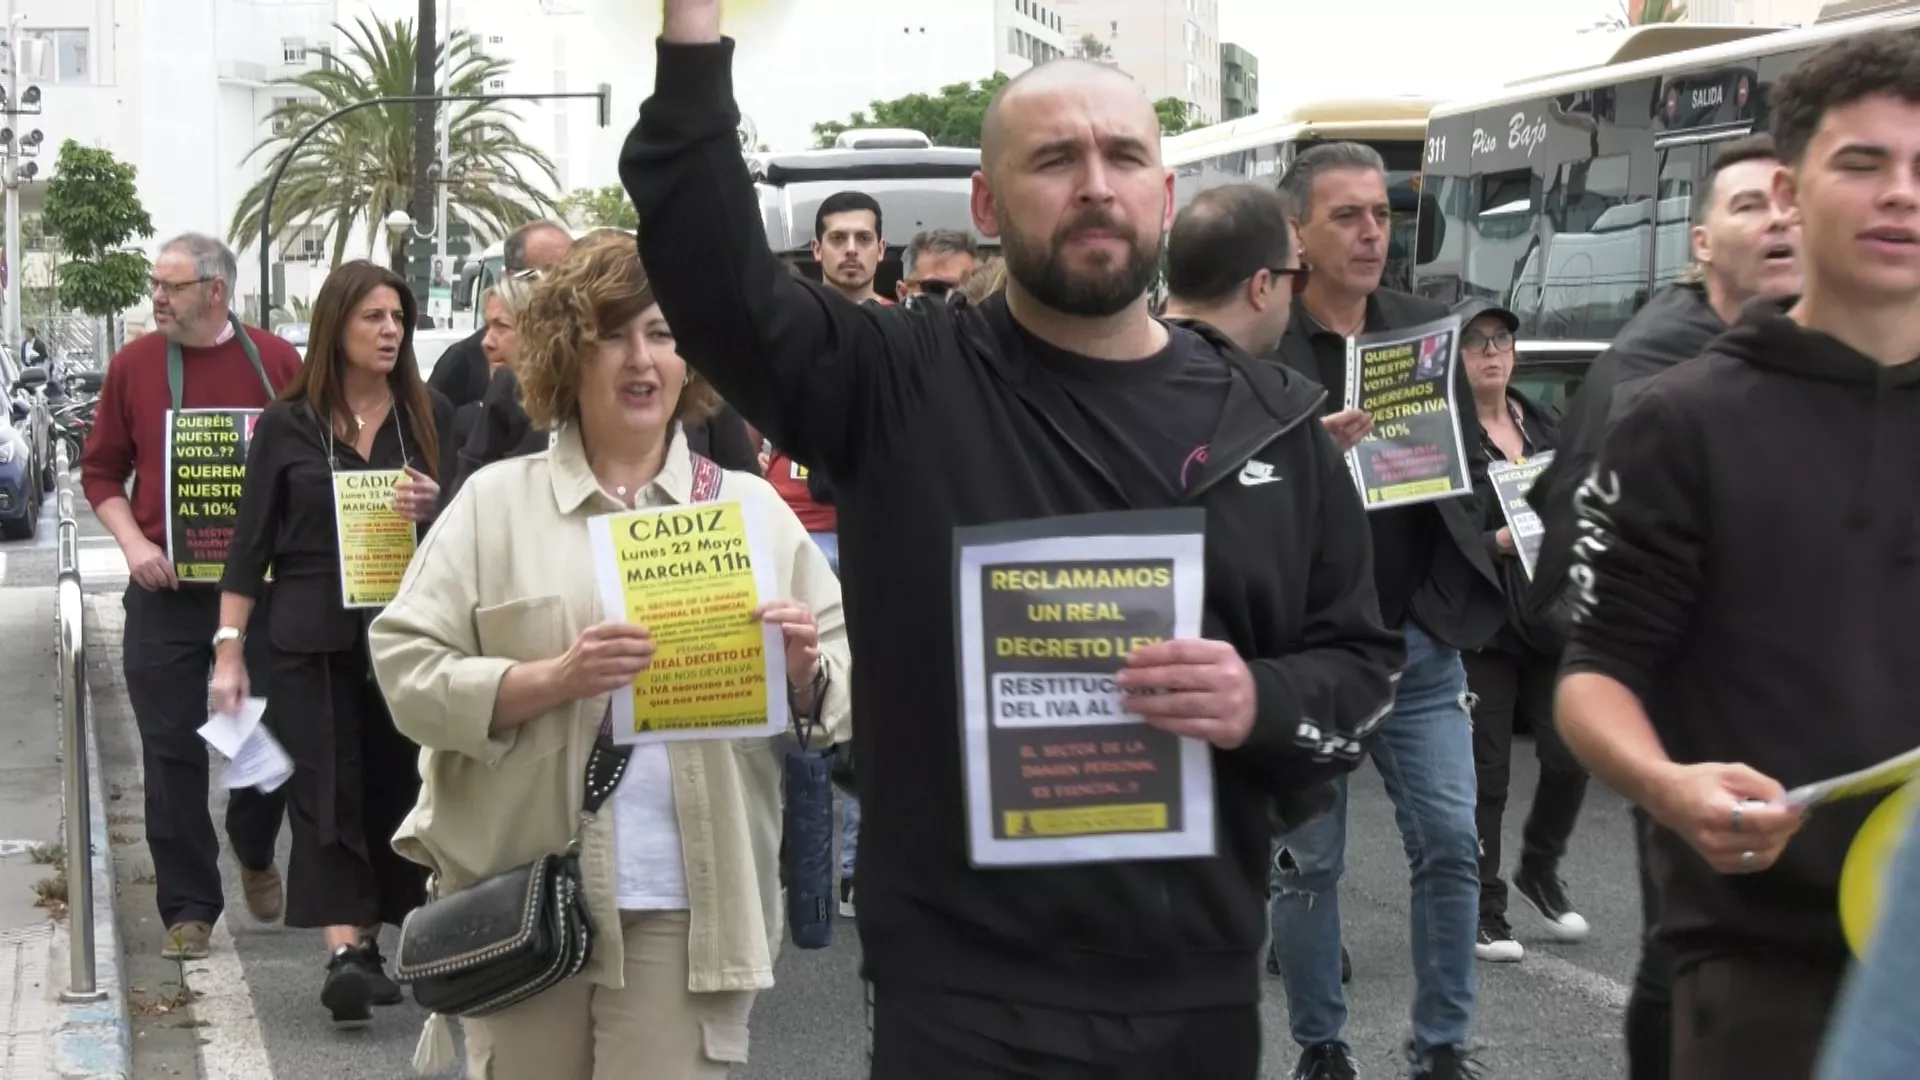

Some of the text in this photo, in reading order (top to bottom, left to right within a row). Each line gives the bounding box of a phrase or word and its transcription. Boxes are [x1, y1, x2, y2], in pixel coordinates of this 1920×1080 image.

[1692, 85, 1723, 109] SALIDA
[1427, 112, 1547, 163] 311 Piso Bajo
[1365, 357, 1415, 378] NUESTRO
[1364, 382, 1434, 409] QUEREMOS
[1371, 398, 1447, 422] UESTRO IVA
[176, 414, 233, 428] QUERÉIS
[1379, 423, 1410, 439] 10%
[176, 432, 239, 442] NUESTRO
[178, 466, 245, 478] QUEREM
[178, 484, 242, 497] NUESTR
[341, 491, 366, 499] Lunes
[369, 490, 380, 498] 22
[178, 503, 236, 516] AL 10%
[342, 503, 387, 511] MARCHA
[629, 509, 726, 541] CÁDIZ
[621, 537, 742, 562] Lunes 22 Mayo
[627, 562, 707, 583] MARCHA
[710, 552, 751, 573] 11h
[991, 568, 1170, 590] RECLAMAMOS
[640, 609, 687, 623] PERSONAL
[1028, 602, 1124, 622] UN REAL
[676, 642, 717, 656] PEDIMOS
[996, 637, 1112, 658] DECRETO
[653, 658, 682, 670] REAL
[685, 650, 738, 667] DECRETO
[740, 646, 761, 659] LEY
[650, 664, 753, 684] QUE NOS DEVUELVA
[650, 683, 669, 694] IVA
[740, 674, 764, 685] 10%
[1001, 701, 1041, 718] DEL
[1046, 701, 1082, 717] IVA
[1086, 700, 1114, 715] AL
[1125, 740, 1146, 753] LA
